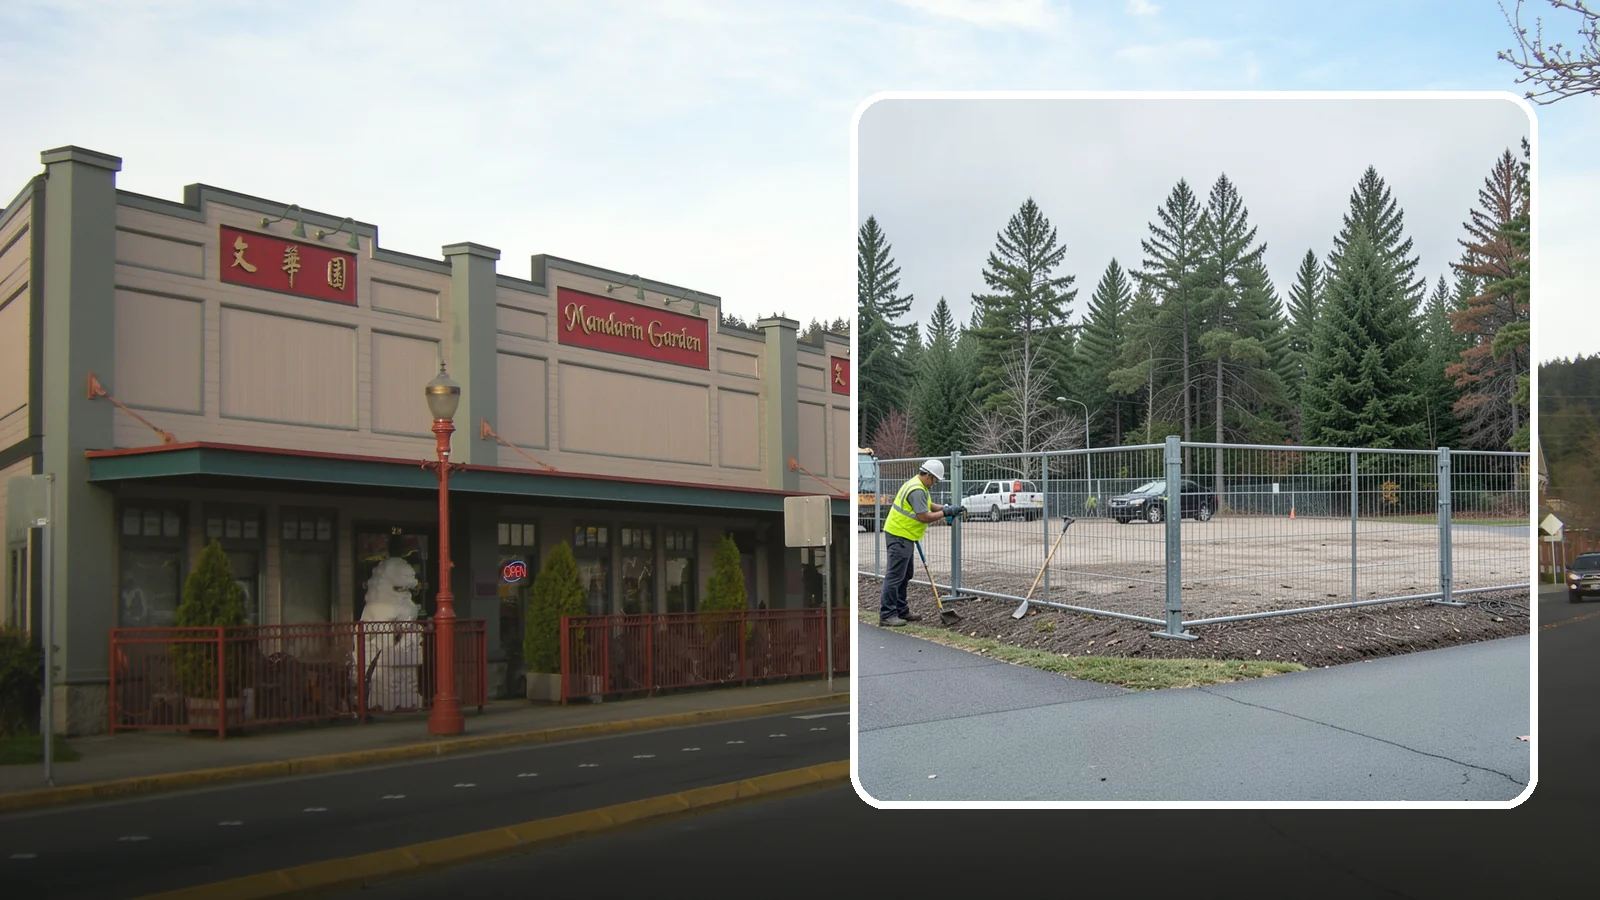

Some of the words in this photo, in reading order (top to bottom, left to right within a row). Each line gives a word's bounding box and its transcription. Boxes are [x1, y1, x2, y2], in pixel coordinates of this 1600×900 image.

[231, 236, 346, 290] 文華園
[565, 302, 644, 341] Mandarin
[648, 320, 701, 352] Garden
[503, 565, 527, 578] OPEN
